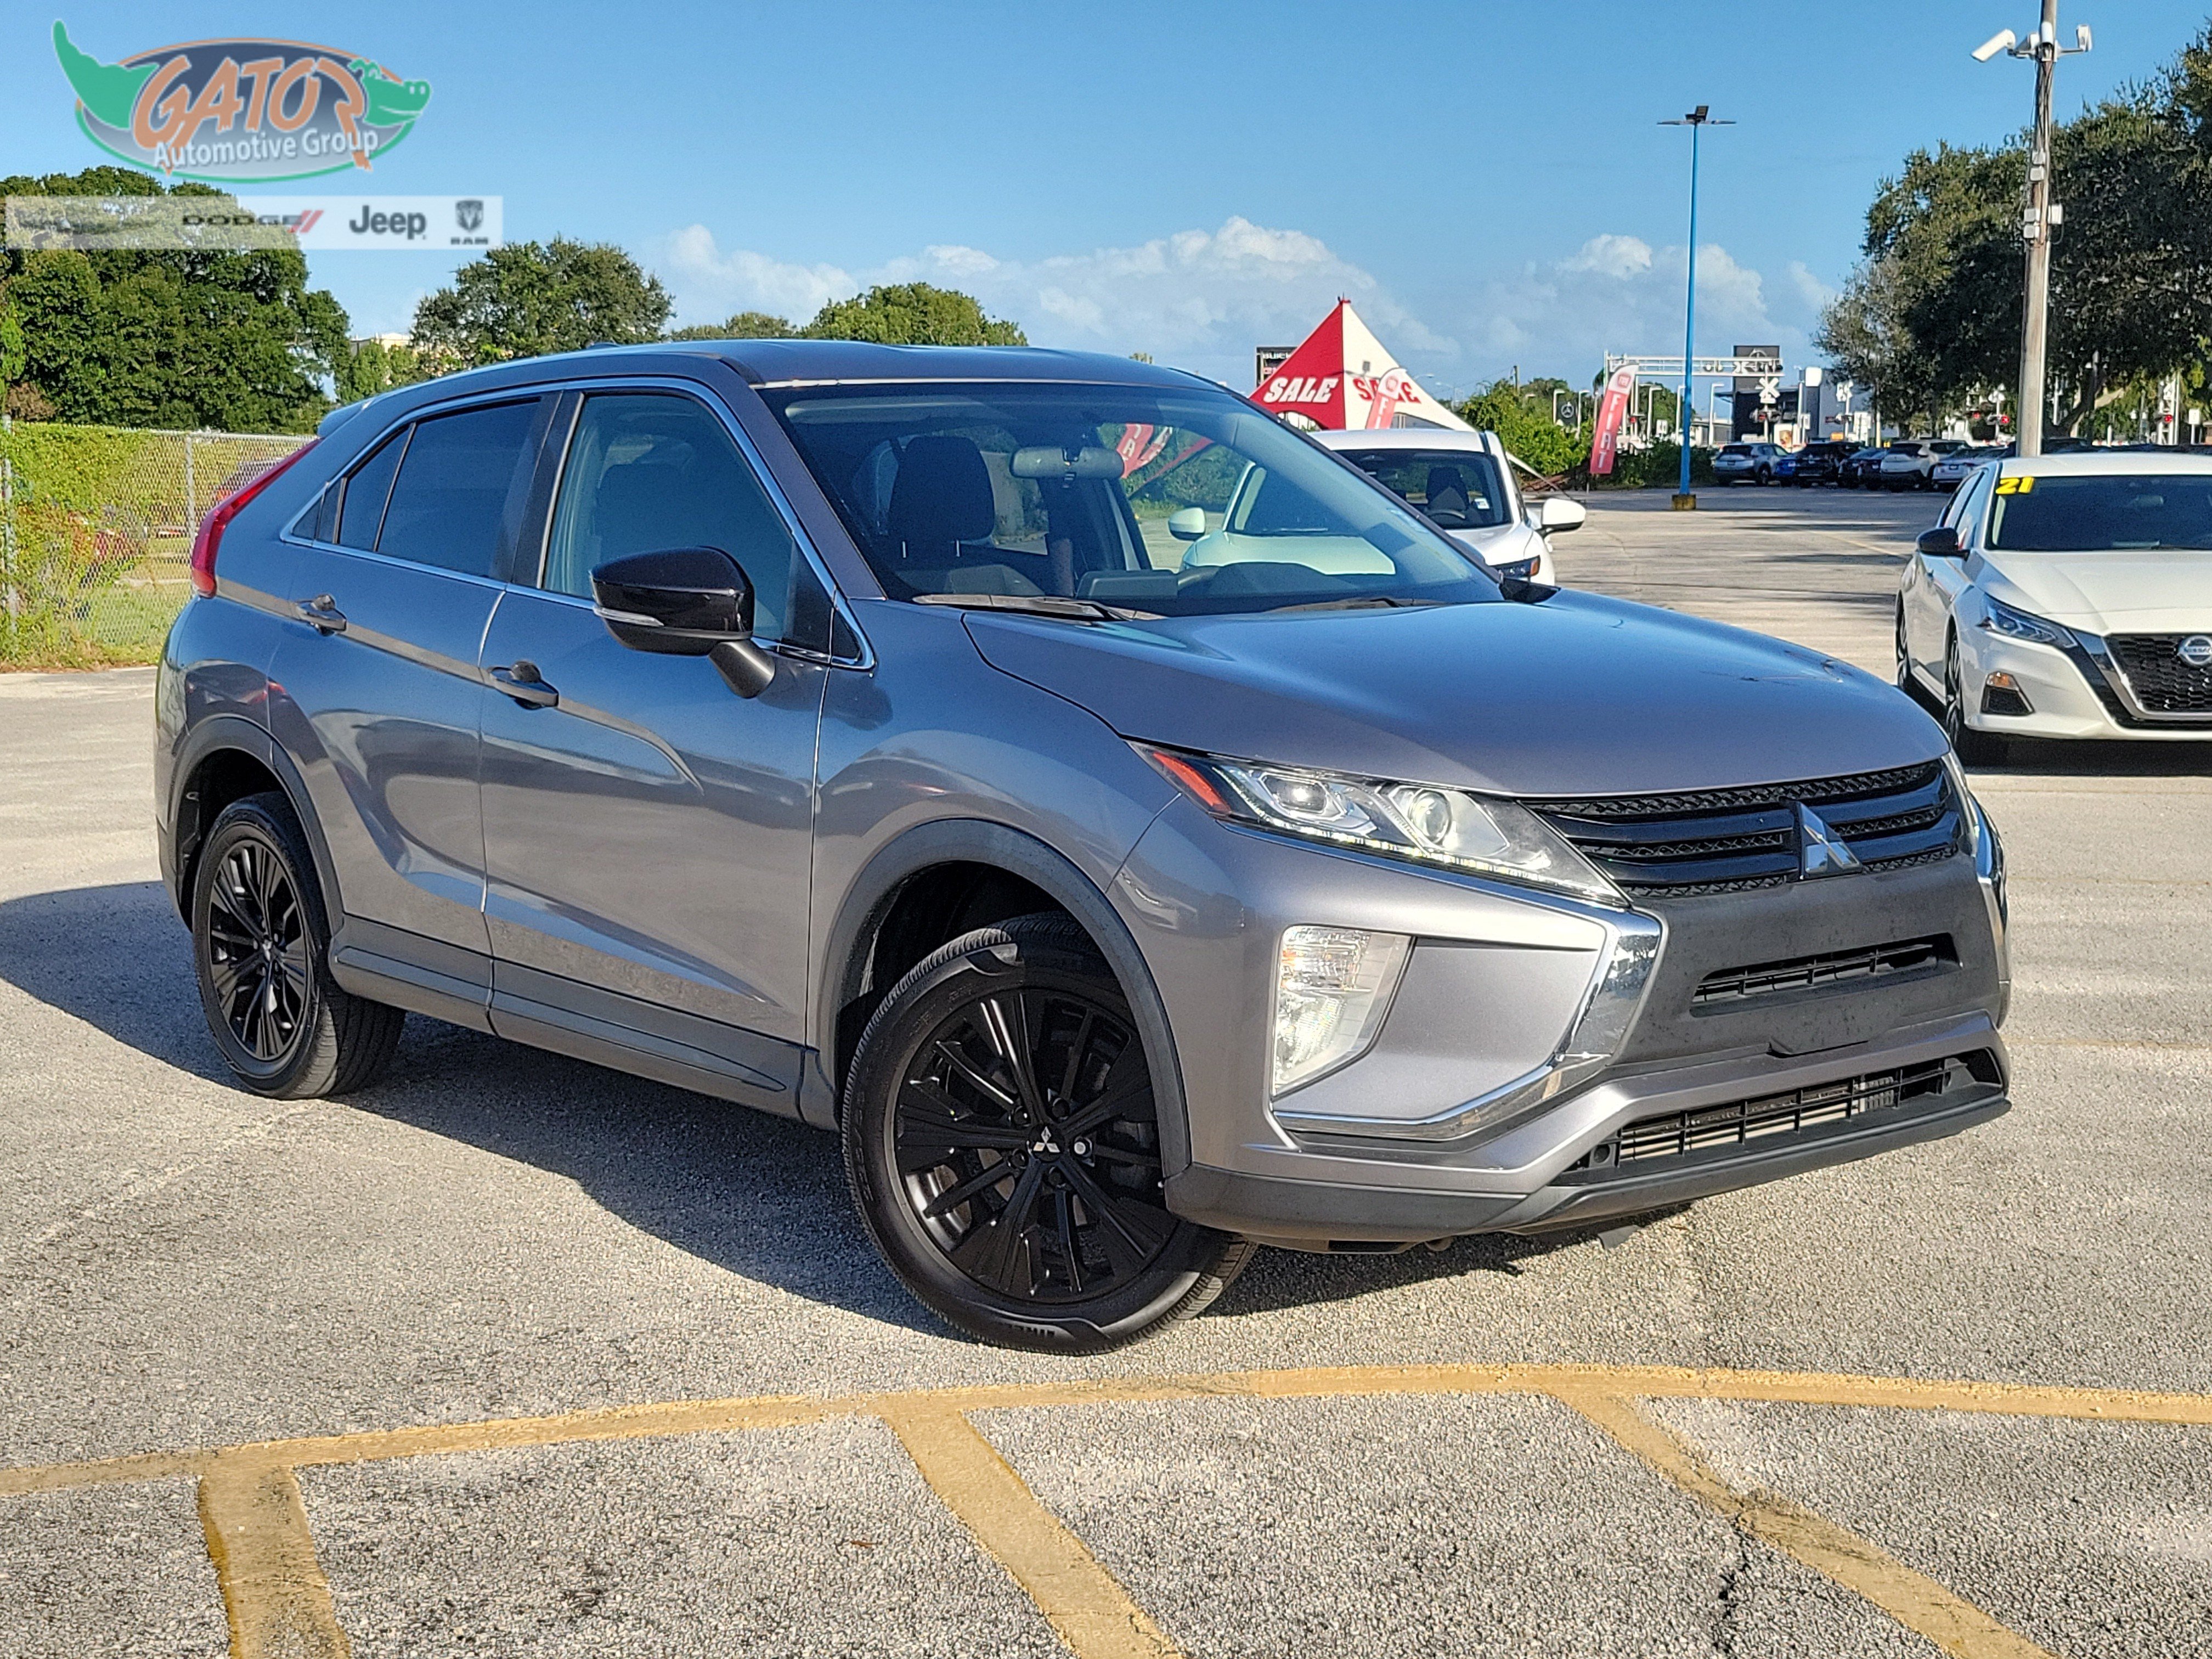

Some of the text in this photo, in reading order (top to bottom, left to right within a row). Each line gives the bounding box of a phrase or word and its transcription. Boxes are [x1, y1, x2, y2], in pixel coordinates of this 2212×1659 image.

[1263, 376, 1339, 403] SALE
[1353, 377, 1422, 404] SE
[1598, 394, 1622, 469] FIAT
[1995, 476, 2035, 494] 21
